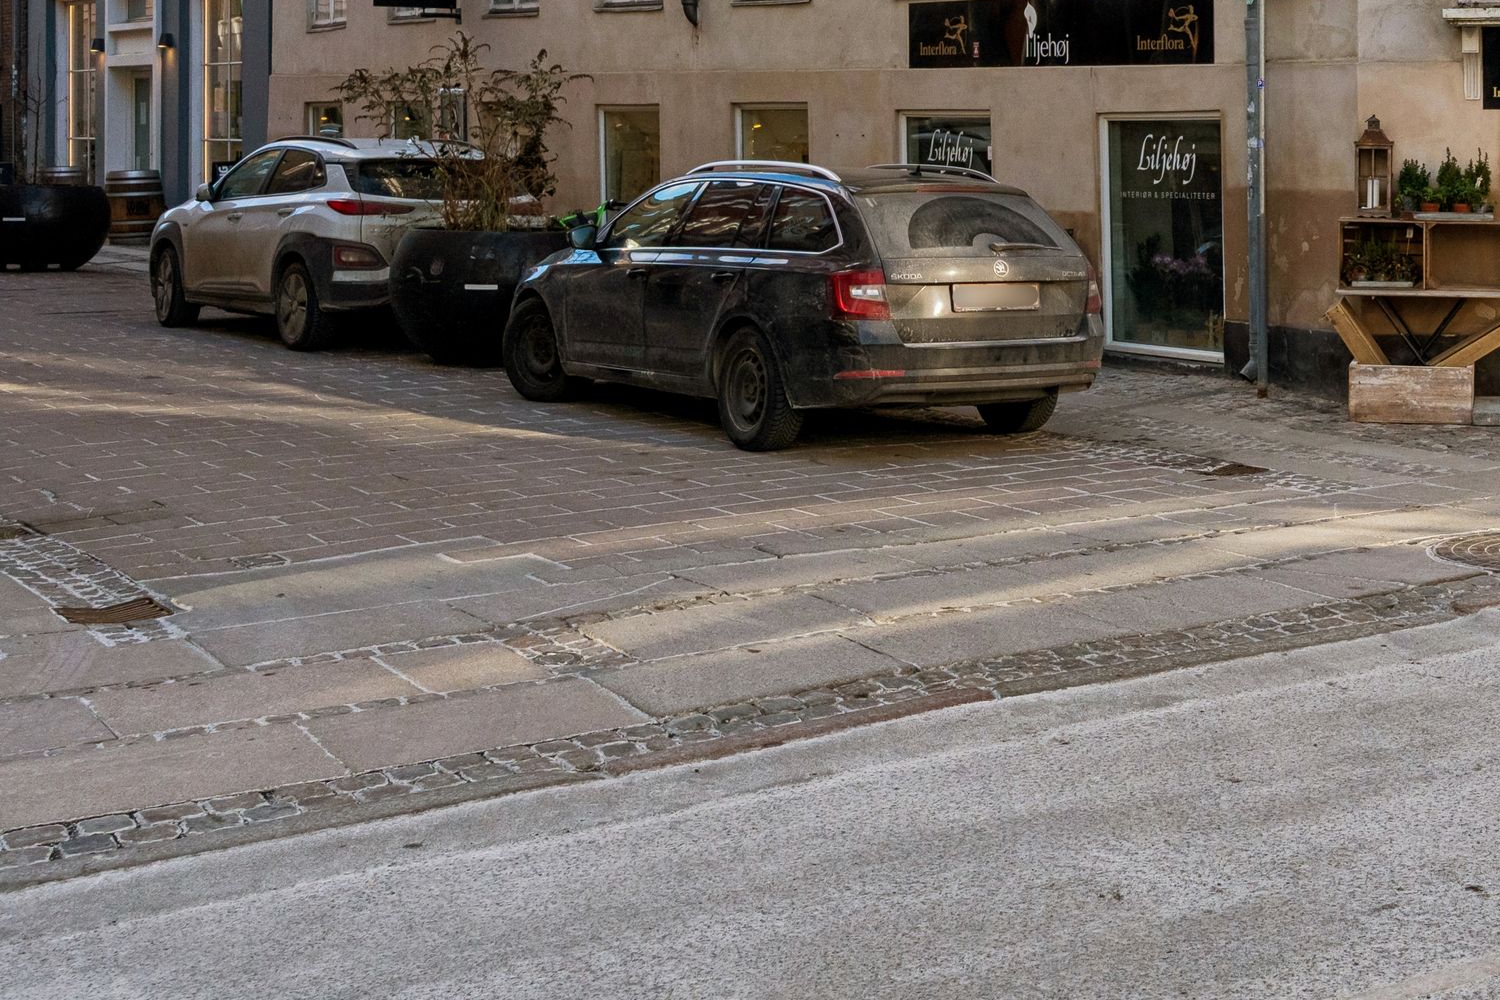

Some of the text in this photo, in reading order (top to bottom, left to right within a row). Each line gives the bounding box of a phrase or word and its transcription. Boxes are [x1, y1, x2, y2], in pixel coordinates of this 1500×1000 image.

[920, 41, 957, 56] Interflora
[1136, 33, 1185, 50] Interflora
[928, 129, 974, 169] Liljehøj
[1137, 133, 1197, 185] Liljehøj
[1161, 191, 1216, 200] SPECIALITETER
